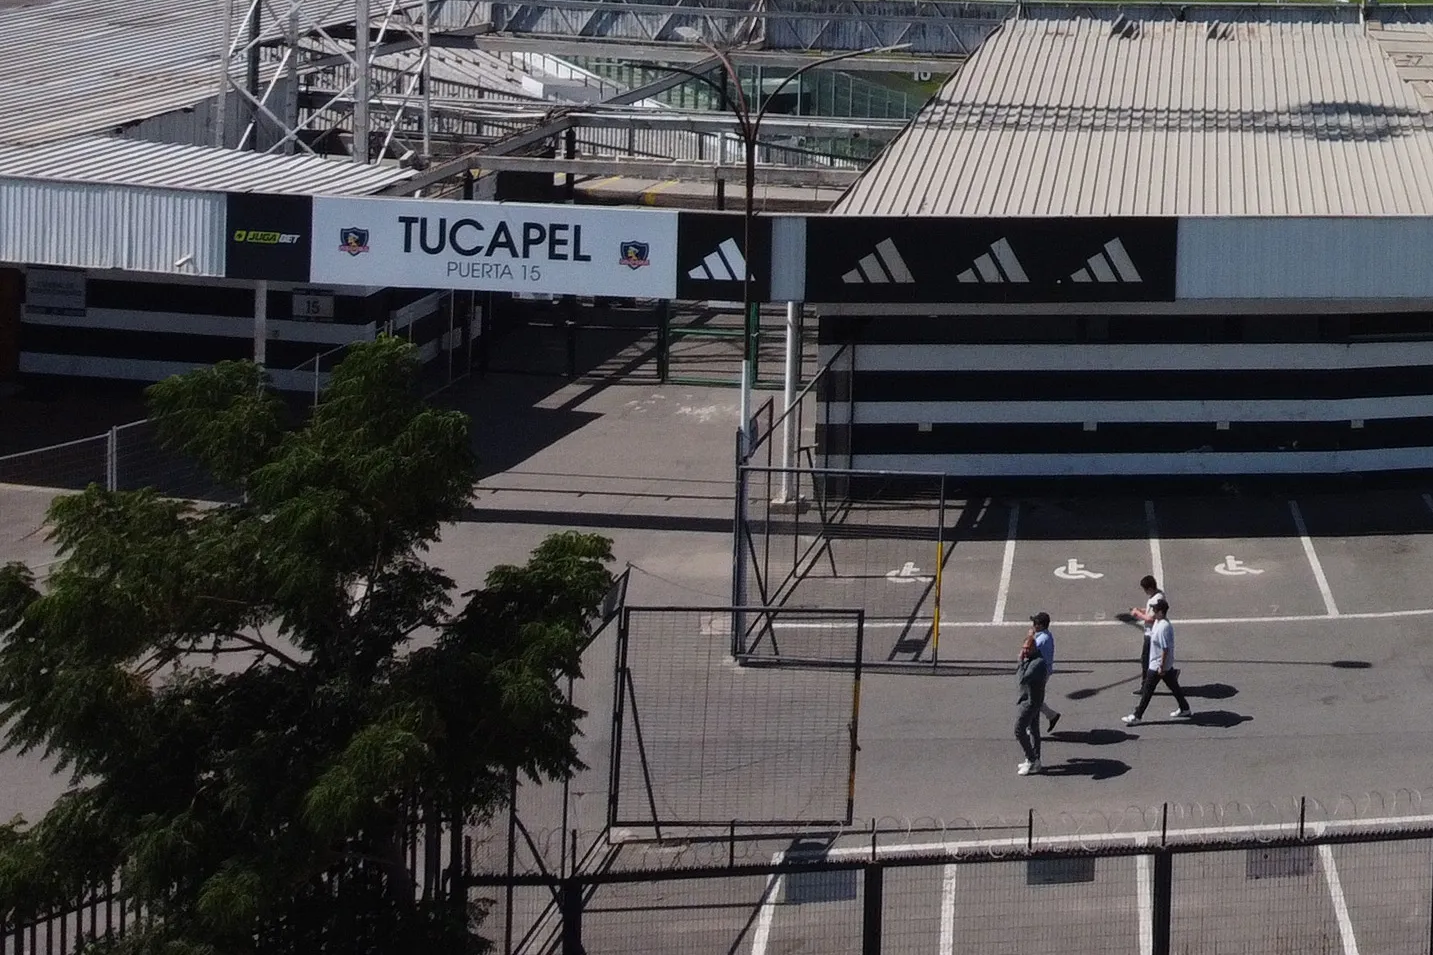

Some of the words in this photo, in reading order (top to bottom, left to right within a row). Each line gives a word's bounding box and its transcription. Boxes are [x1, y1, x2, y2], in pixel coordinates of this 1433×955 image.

[398, 216, 592, 262] TUCAPEL
[446, 261, 513, 280] PUERTA
[521, 264, 541, 282] 15
[306, 299, 320, 314] 15
